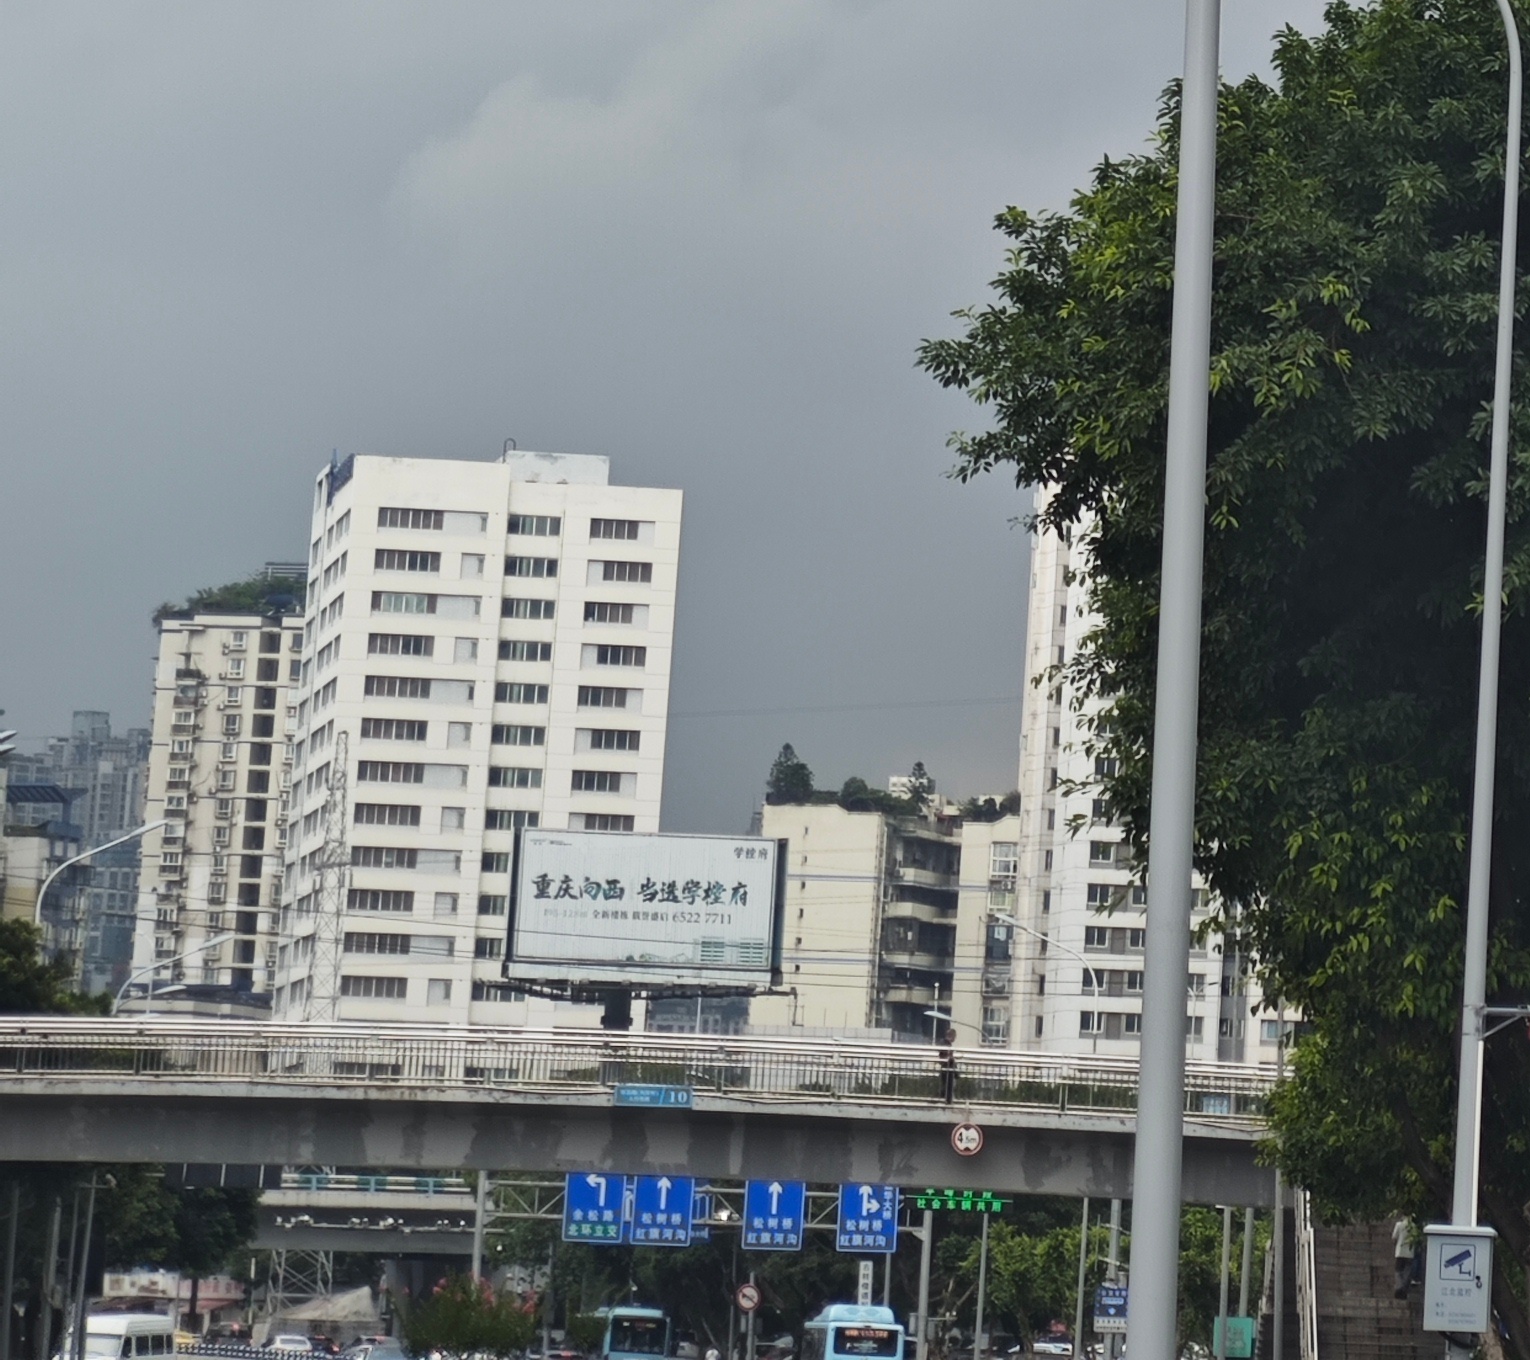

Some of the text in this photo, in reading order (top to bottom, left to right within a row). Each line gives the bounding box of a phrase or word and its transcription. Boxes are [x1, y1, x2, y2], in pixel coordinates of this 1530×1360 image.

[532, 873, 625, 901] 重庆向西
[672, 912, 700, 924] 6522
[704, 913, 732, 925] 7711
[670, 1090, 688, 1104] 10
[572, 1208, 614, 1222] 余松路
[641, 1212, 682, 1226] 松树桥
[753, 1217, 793, 1230] 松树桥
[846, 1219, 883, 1231] 松树桥
[568, 1223, 618, 1238] 北环立交
[635, 1228, 687, 1241] 红旗河沟
[746, 1232, 798, 1245] 红旗河沟
[839, 1234, 886, 1247] 红旗河沟
